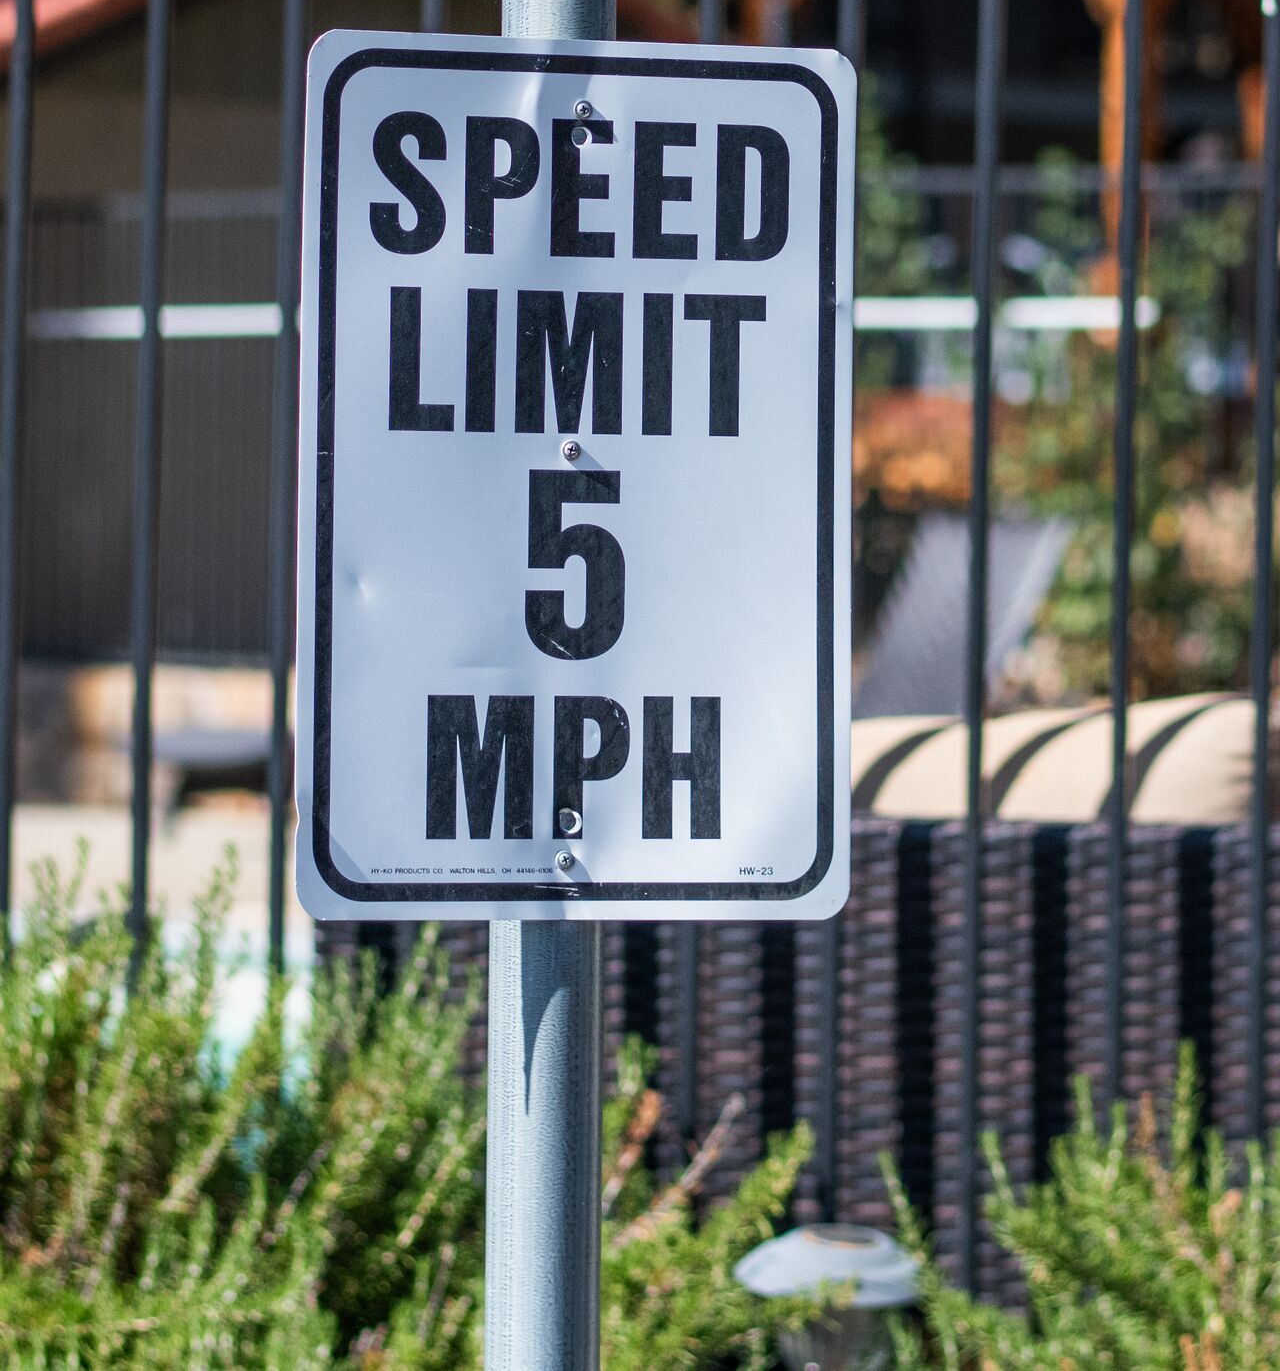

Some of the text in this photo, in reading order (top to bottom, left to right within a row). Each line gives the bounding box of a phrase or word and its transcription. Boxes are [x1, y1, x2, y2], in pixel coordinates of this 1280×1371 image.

[369, 111, 790, 262] SPEED
[387, 286, 768, 437] LIMIT
[524, 469, 627, 660] 5
[425, 694, 722, 841] MPH
[371, 867, 393, 875] HY-KO
[395, 867, 430, 875] PRODUCTS
[449, 867, 475, 875] WALTON
[739, 866, 774, 876] HW-23
